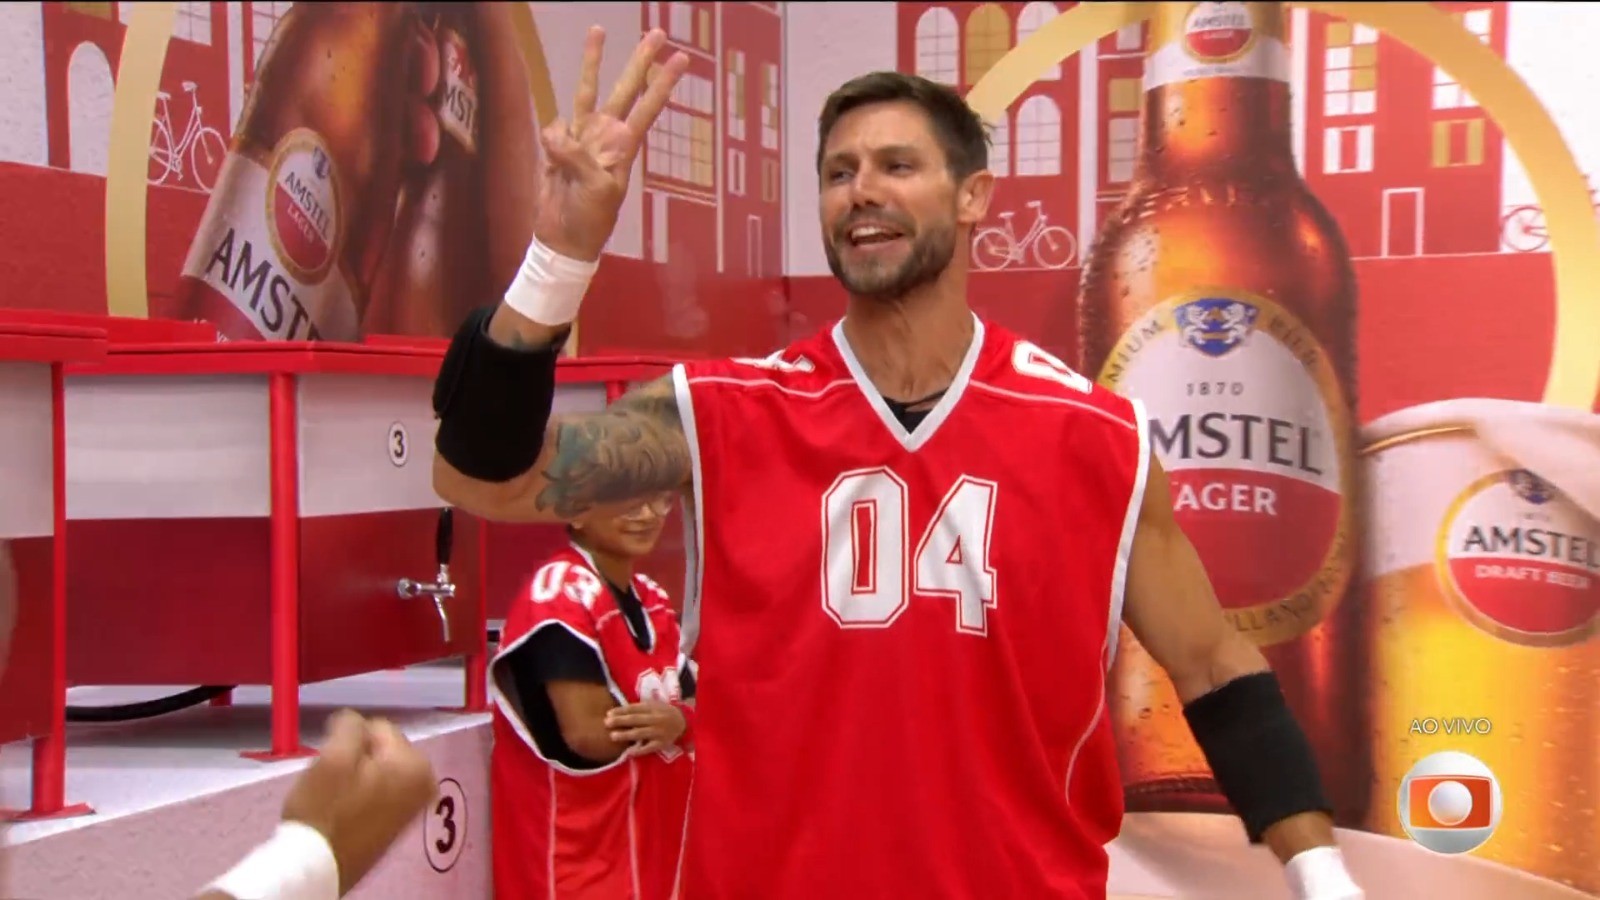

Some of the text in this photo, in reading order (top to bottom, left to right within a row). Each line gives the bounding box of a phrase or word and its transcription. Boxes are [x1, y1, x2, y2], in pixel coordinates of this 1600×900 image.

[284, 171, 331, 241] AMSTEL
[1105, 319, 1165, 383] MIUM
[1186, 381, 1245, 397] 1870
[393, 429, 406, 459] 3
[1147, 411, 1324, 477] MSTEL
[1170, 480, 1278, 517] AGER
[821, 465, 998, 637] 04
[1474, 564, 1542, 582] DRAFT
[435, 795, 457, 854] 3
